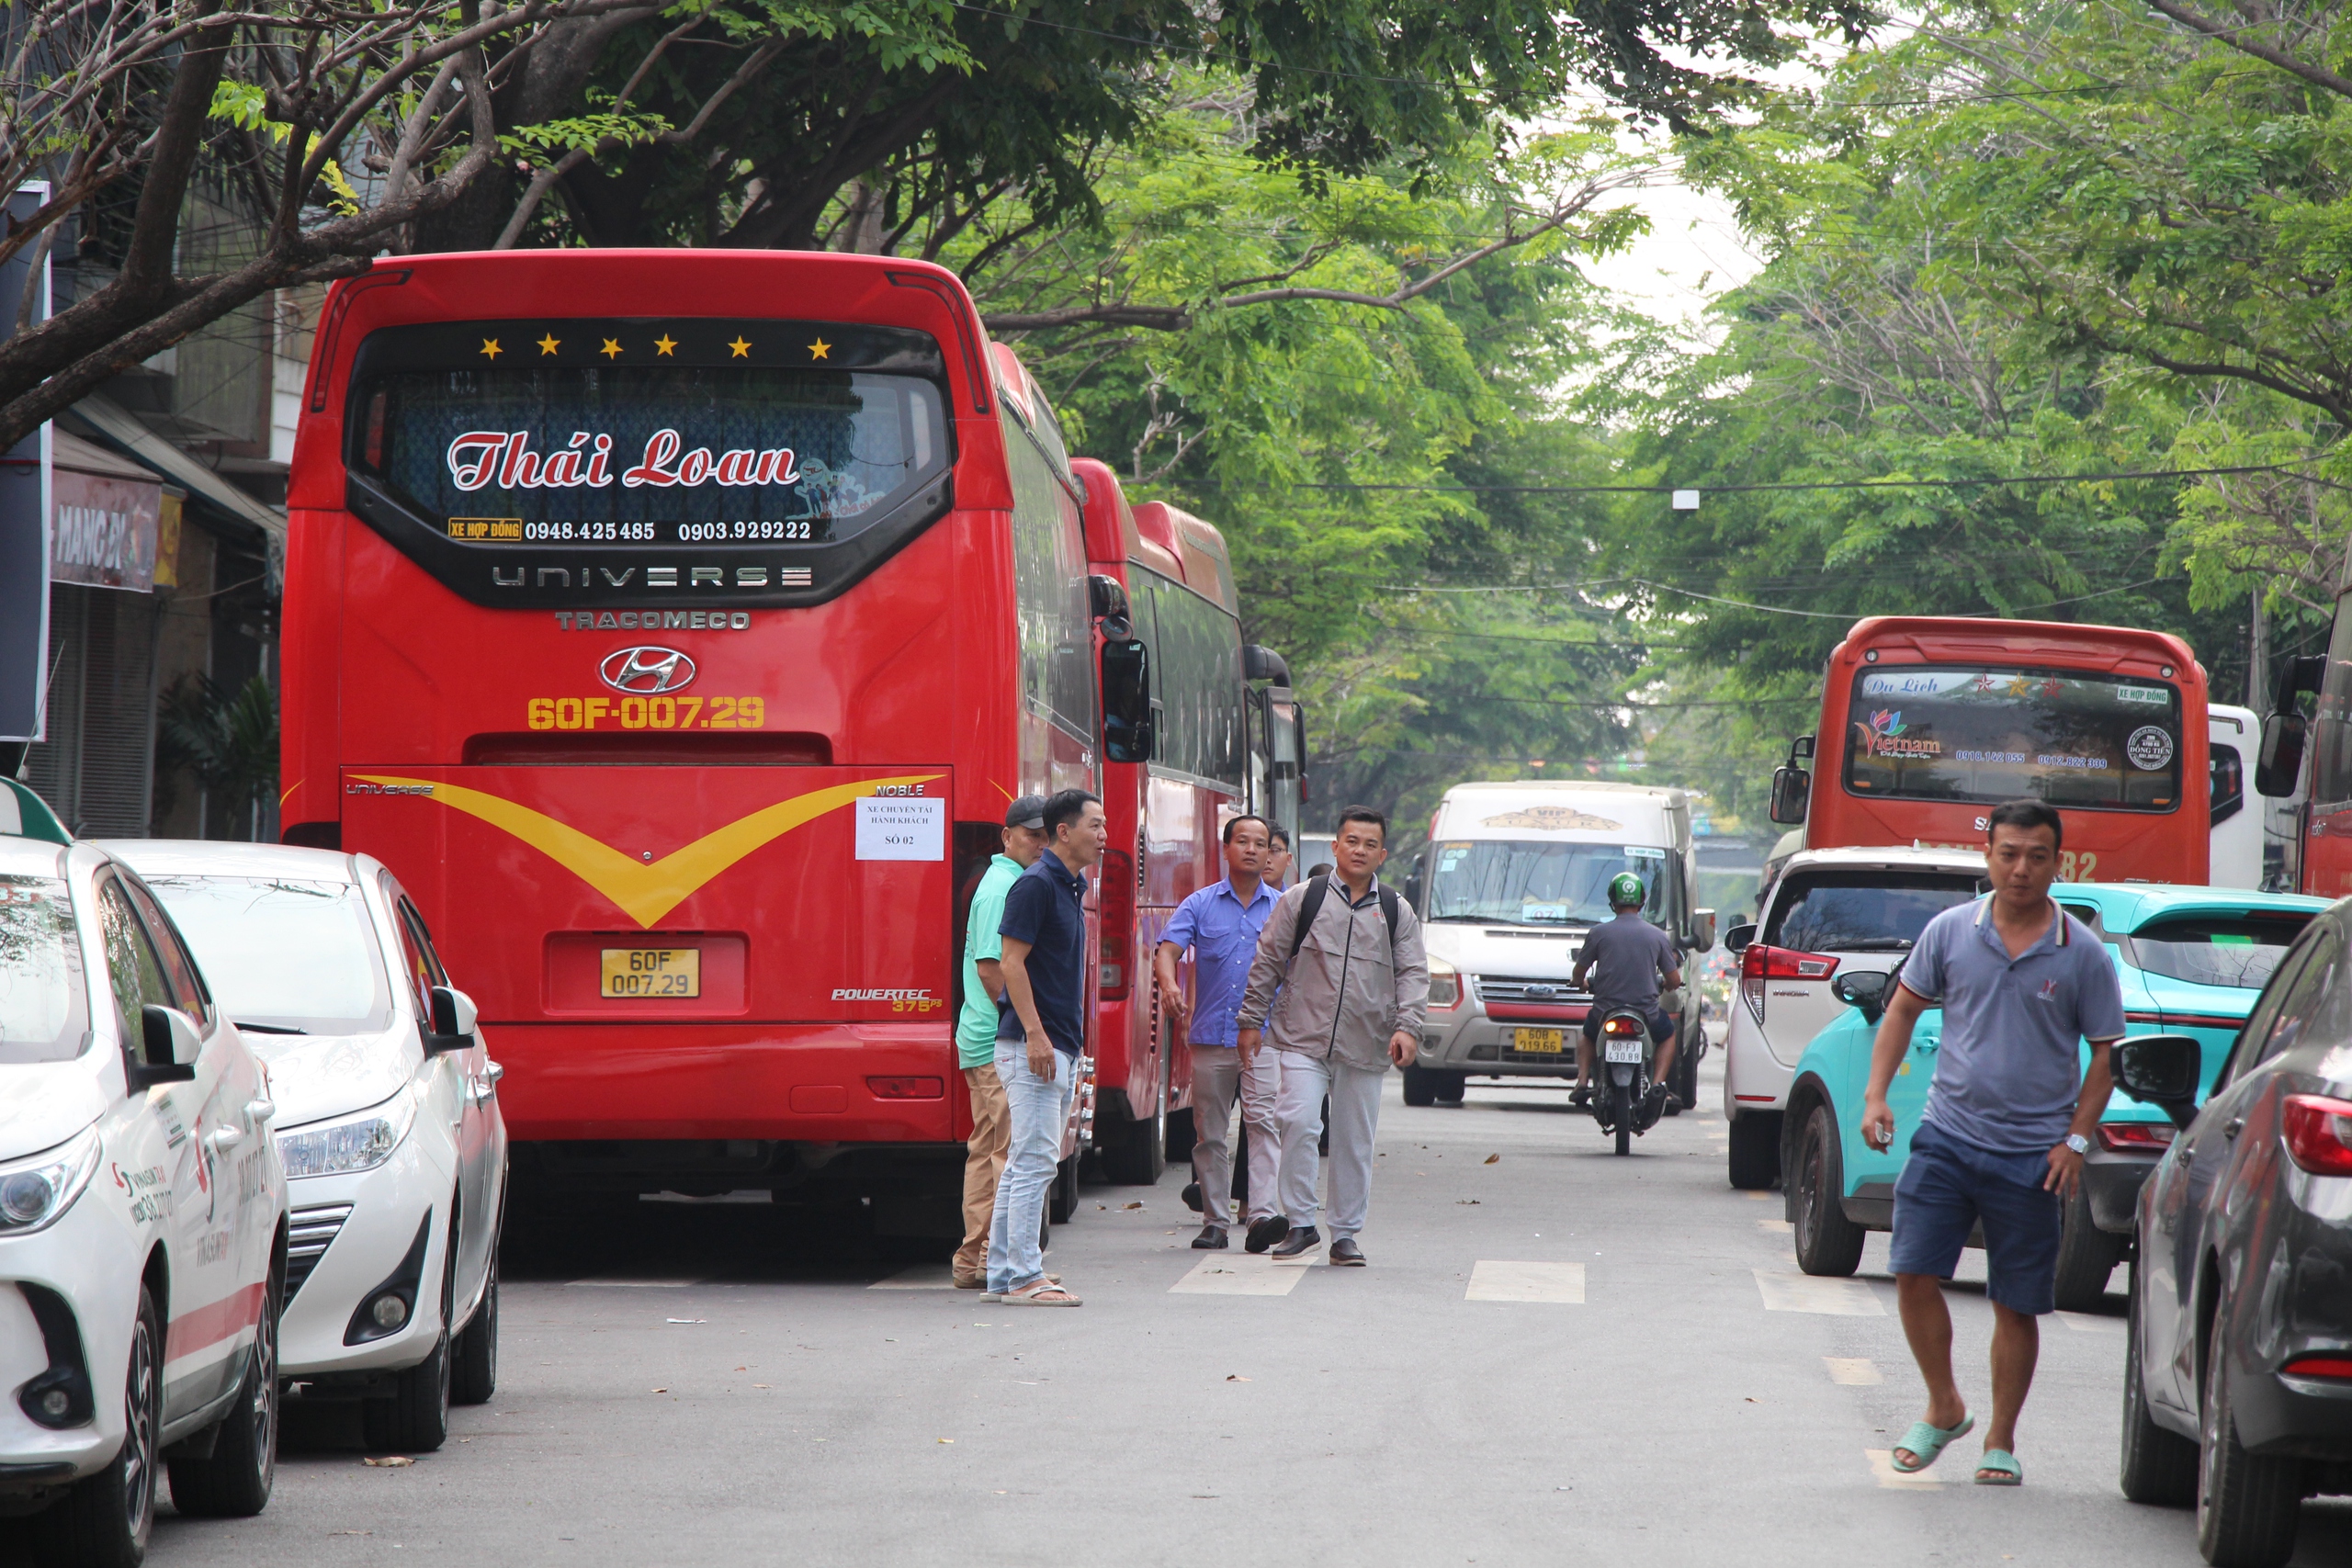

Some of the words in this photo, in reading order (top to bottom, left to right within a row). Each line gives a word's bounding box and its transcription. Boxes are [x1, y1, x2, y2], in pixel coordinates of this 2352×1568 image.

[447, 431, 614, 491] Thái
[621, 428, 800, 488] Loan
[451, 523, 465, 536] XE
[468, 521, 489, 539] HỢP
[678, 521, 811, 541] 0903.929222
[555, 611, 751, 631] TRACOMECO
[2120, 688, 2128, 698] XE
[527, 696, 764, 729] 60F-007.29
[1854, 722, 1941, 759] Vietnam
[346, 784, 435, 795] UNIVERSE
[876, 784, 925, 797] NOBLE
[885, 833, 900, 845] SỐ
[902, 836, 914, 845] 02
[630, 952, 671, 971] 60F
[613, 975, 688, 994] 007.29
[831, 988, 932, 1001] POWERTEC
